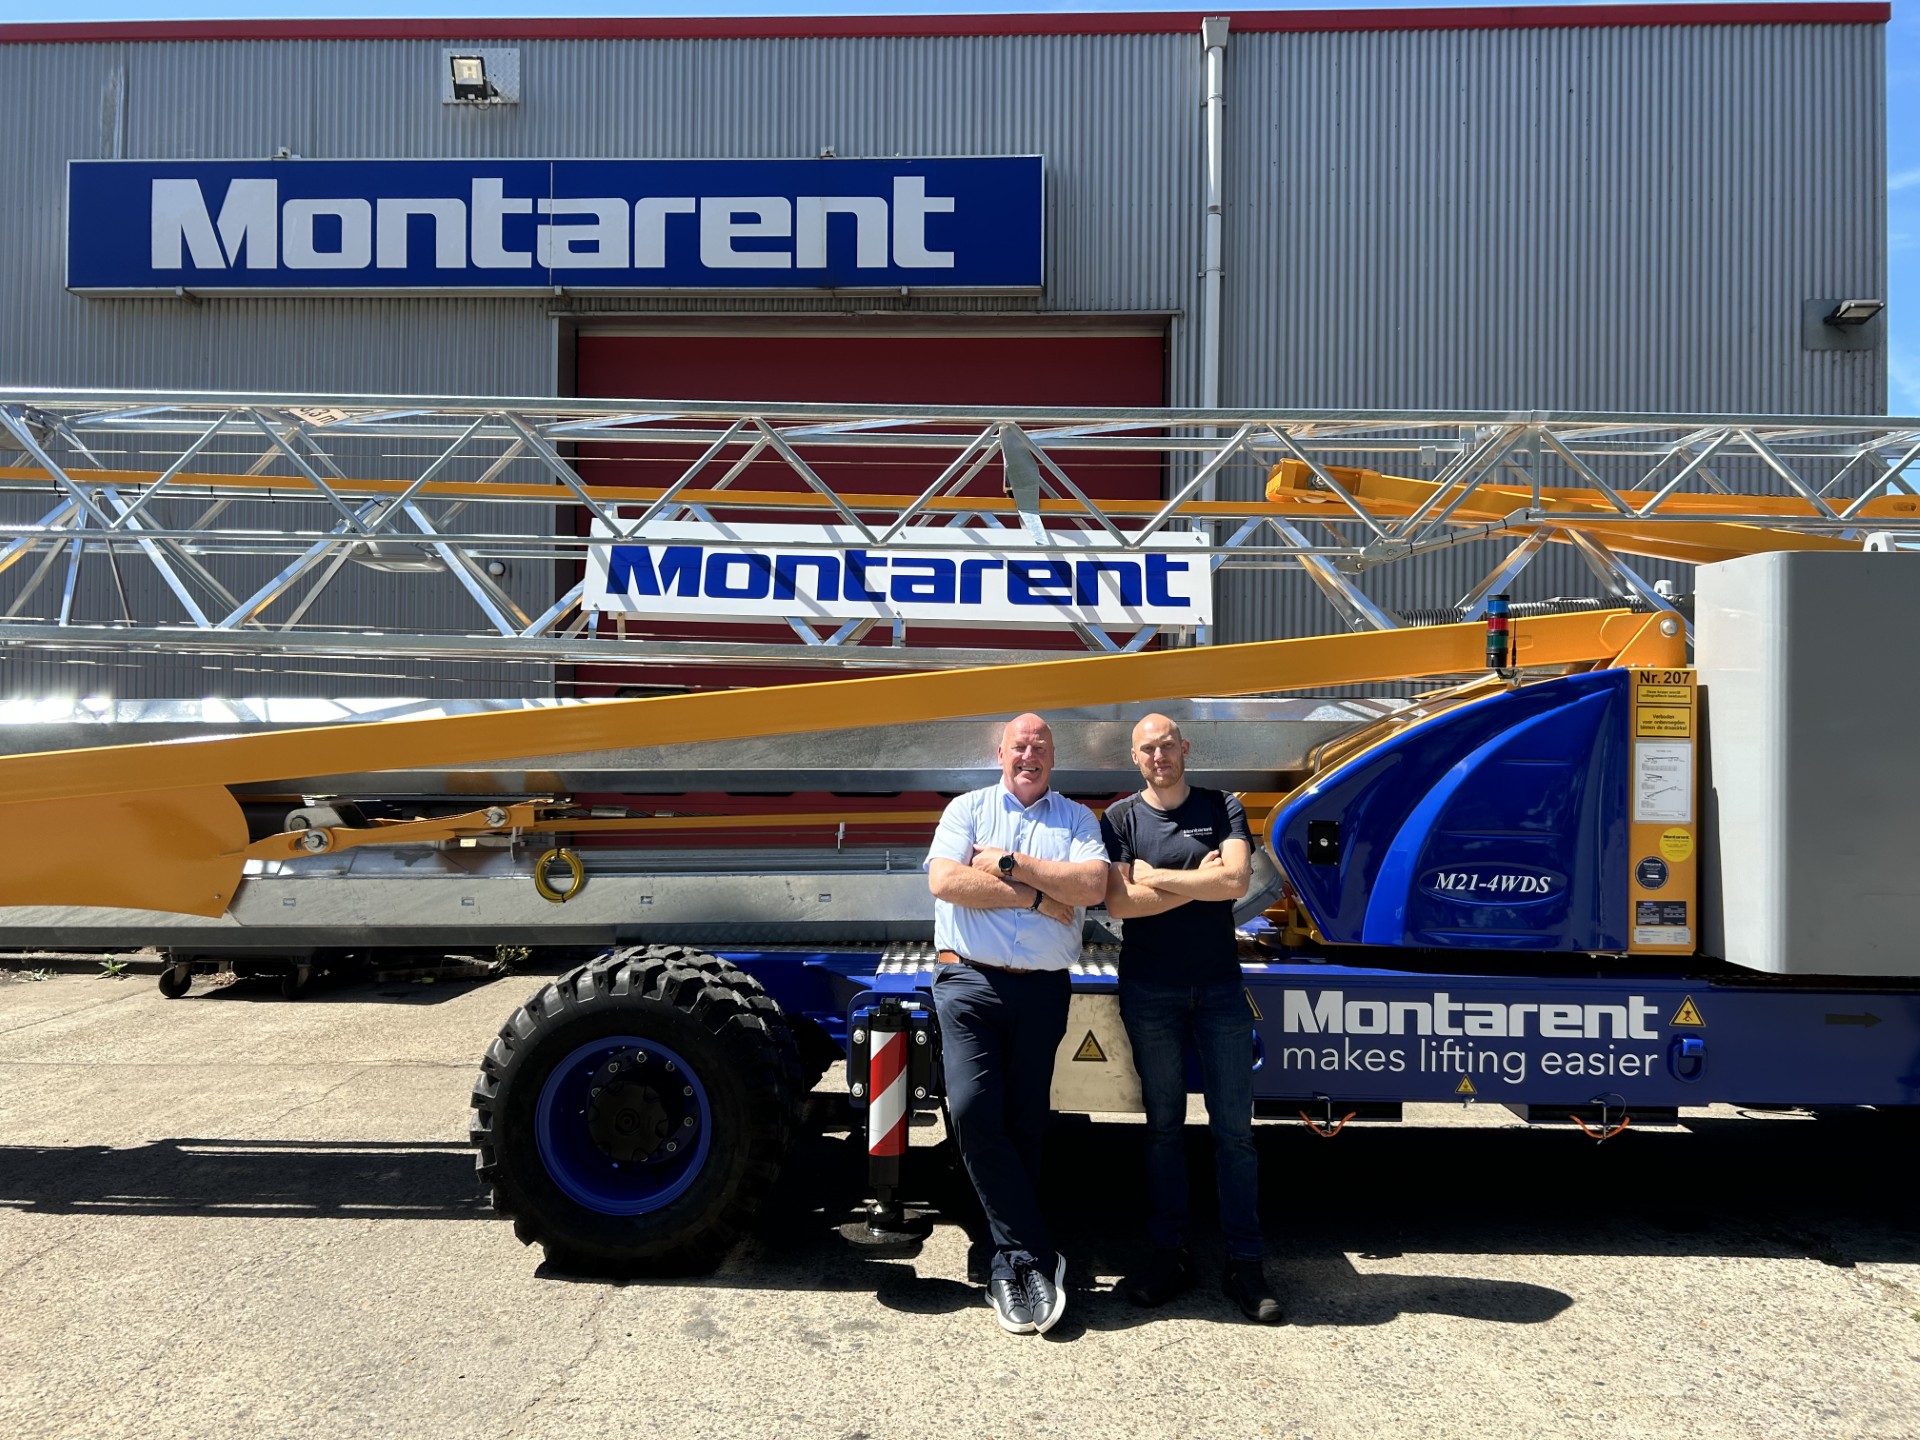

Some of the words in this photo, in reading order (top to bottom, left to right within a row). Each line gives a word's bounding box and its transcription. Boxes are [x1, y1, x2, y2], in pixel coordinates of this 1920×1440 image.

[151, 176, 955, 269] Montarent
[316, 415, 338, 425] m
[605, 535, 1191, 608] Montarent
[1640, 671, 1661, 684] Nr.
[1663, 671, 1691, 684] 207
[1433, 872, 1551, 894] M21-4WDS
[1283, 989, 1659, 1040] Montarent
[1283, 1037, 1406, 1072] makes
[1420, 1038, 1526, 1084] lifting
[1540, 1044, 1658, 1077] easier
